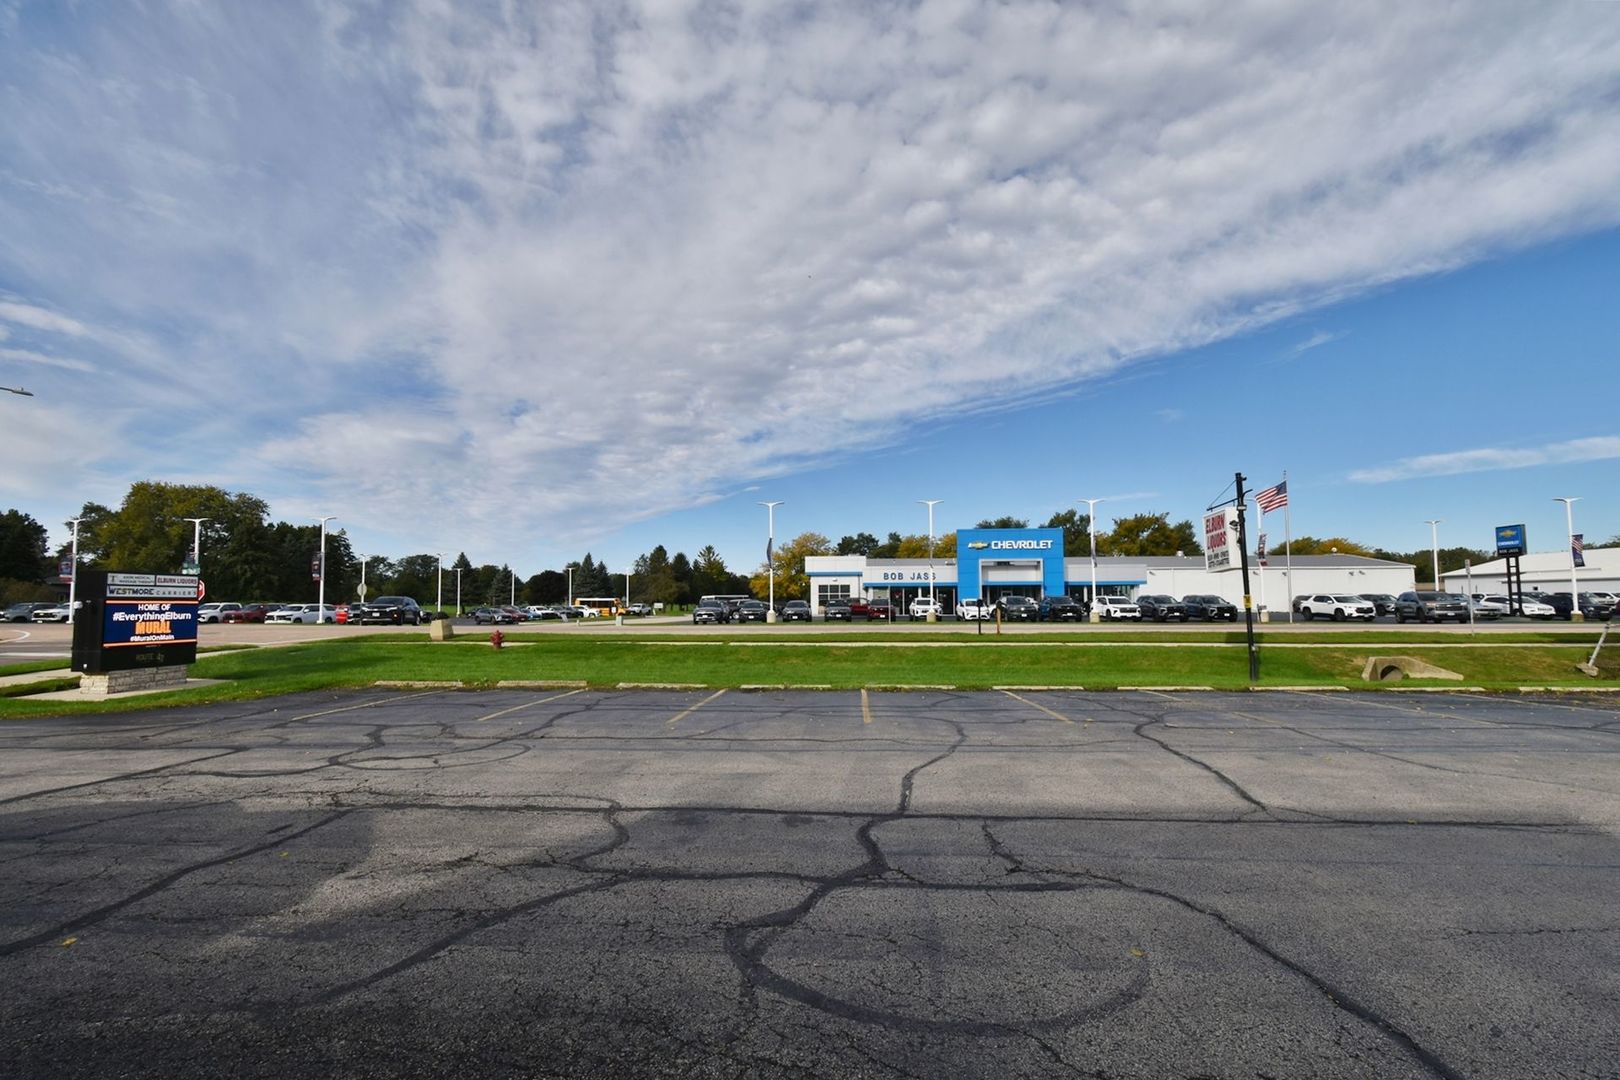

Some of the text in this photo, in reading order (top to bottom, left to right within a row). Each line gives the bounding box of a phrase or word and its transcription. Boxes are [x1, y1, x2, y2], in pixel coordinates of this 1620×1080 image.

[1205, 512, 1225, 534] ELBURN
[991, 540, 1053, 549] CHEVROLET
[1206, 530, 1227, 552] LIQUORS
[883, 572, 936, 580] BOB JASS
[108, 585, 154, 595] WESTMORE
[112, 611, 192, 622] #EverythingElburn
[135, 621, 171, 634] MURAL
[130, 634, 175, 642] #MuralOnMain
